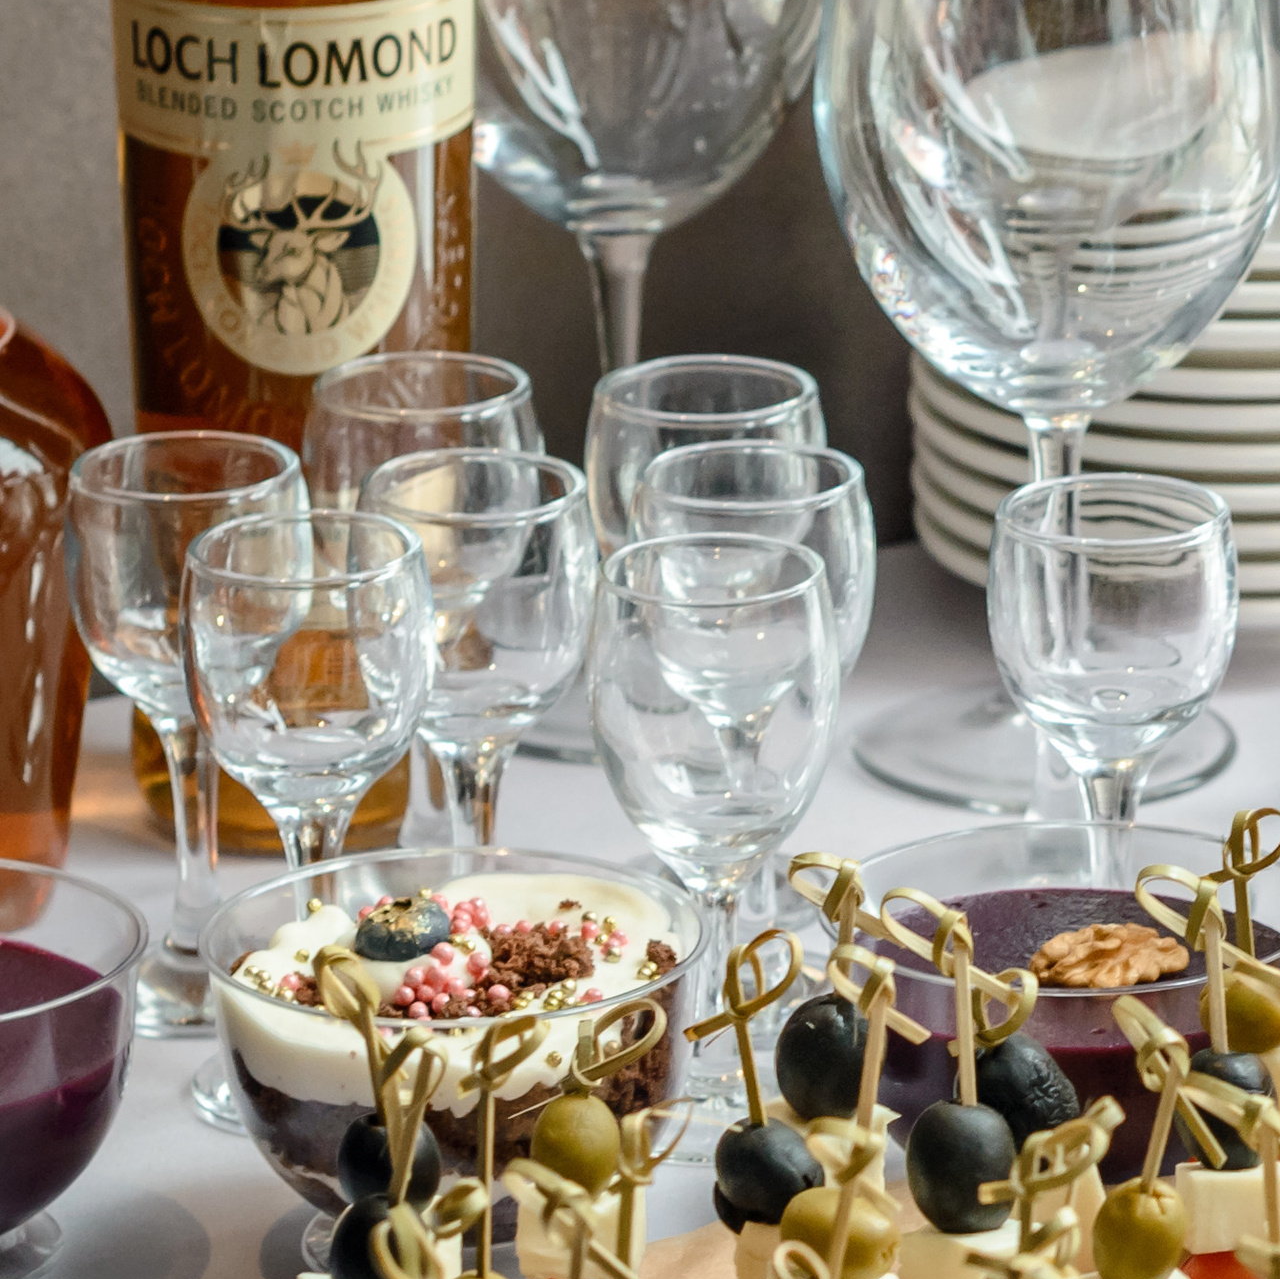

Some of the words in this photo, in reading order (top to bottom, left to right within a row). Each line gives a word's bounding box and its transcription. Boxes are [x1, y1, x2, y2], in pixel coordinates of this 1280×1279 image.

[131, 20, 239, 85] LOCH
[257, 17, 458, 90] LOMOND
[136, 78, 239, 121] BLENDED
[251, 95, 365, 124] SCOTCH
[376, 74, 455, 115] WHISKY
